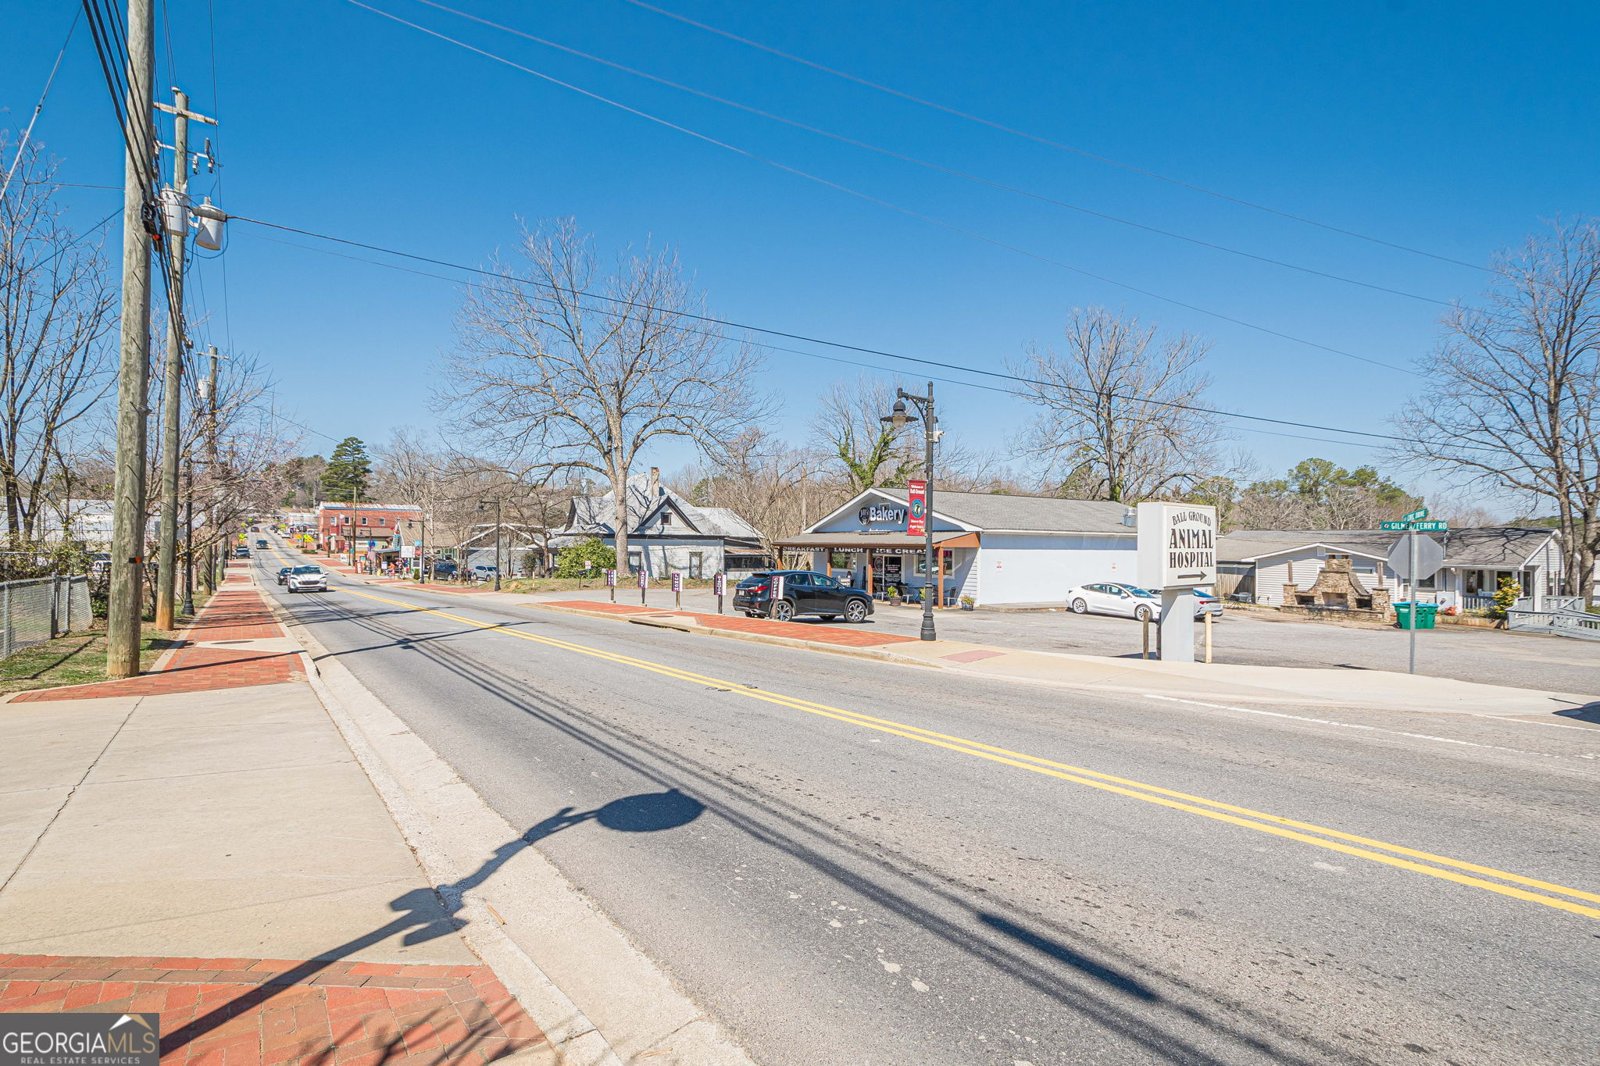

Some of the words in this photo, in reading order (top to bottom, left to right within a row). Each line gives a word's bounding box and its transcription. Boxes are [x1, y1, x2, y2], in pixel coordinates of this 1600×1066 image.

[870, 506, 904, 524] Bakery
[1172, 512, 1187, 526] BALL
[1188, 511, 1211, 526] GROUND
[1169, 528, 1214, 549] ANIMAL
[1169, 552, 1214, 568] HOSPITAL
